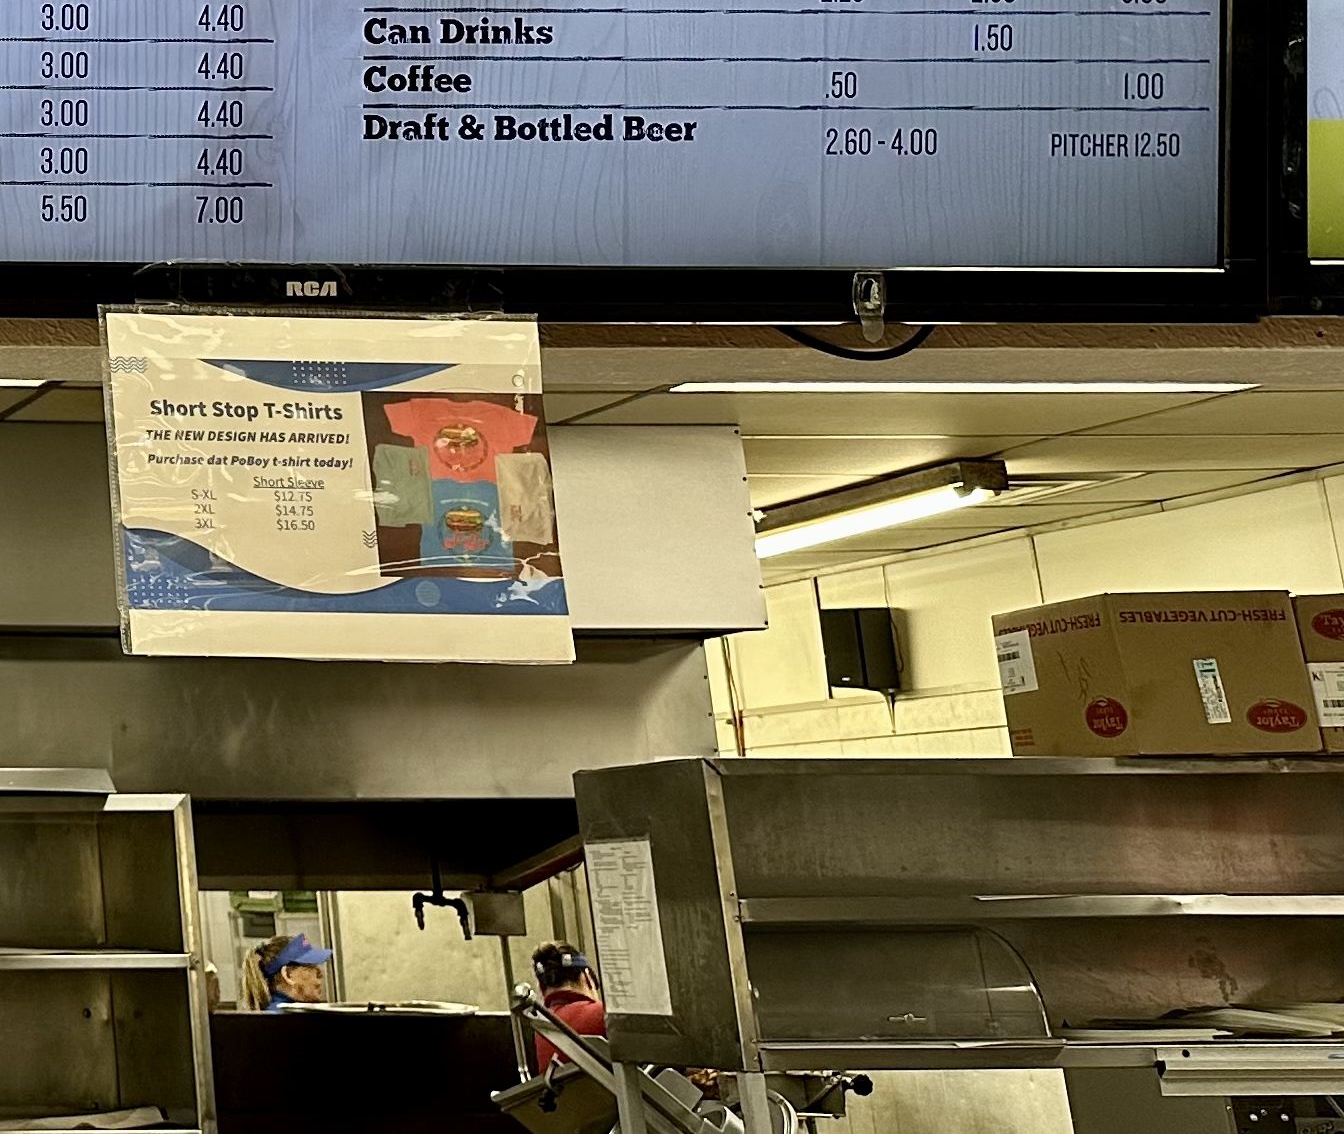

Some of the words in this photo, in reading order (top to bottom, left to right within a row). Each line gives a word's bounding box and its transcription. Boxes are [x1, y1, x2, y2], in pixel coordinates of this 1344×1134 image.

[363, 113, 450, 141] Draft
[458, 114, 485, 141] &
[493, 113, 614, 142] Bottled
[622, 115, 698, 142] Beer
[825, 127, 871, 156] 2.60
[891, 128, 938, 156] 4.00
[1051, 133, 1129, 158] PITCHER
[1135, 132, 1180, 158] 12.50
[286, 281, 337, 297] RCA
[151, 400, 207, 416] Short
[213, 402, 258, 421] Stop
[264, 402, 342, 420] T-Shirts
[146, 430, 171, 440] THE
[175, 430, 204, 440] NEW
[208, 431, 256, 442] DESIGN
[260, 432, 285, 442] HAS
[288, 433, 349, 444] ARRIVED!
[207, 455, 228, 465] dat
[231, 456, 270, 468] PoBoy
[273, 456, 310, 467] t-shirt
[314, 457, 353, 470] today!
[254, 477, 284, 488] Short
[276, 505, 313, 516] $14.75
[277, 519, 314, 530] $16.50
[1118, 609, 1209, 624] VEGETABLES
[1211, 608, 1287, 623] FRESH-CUT
[1050, 612, 1101, 636] FRESH-CUT
